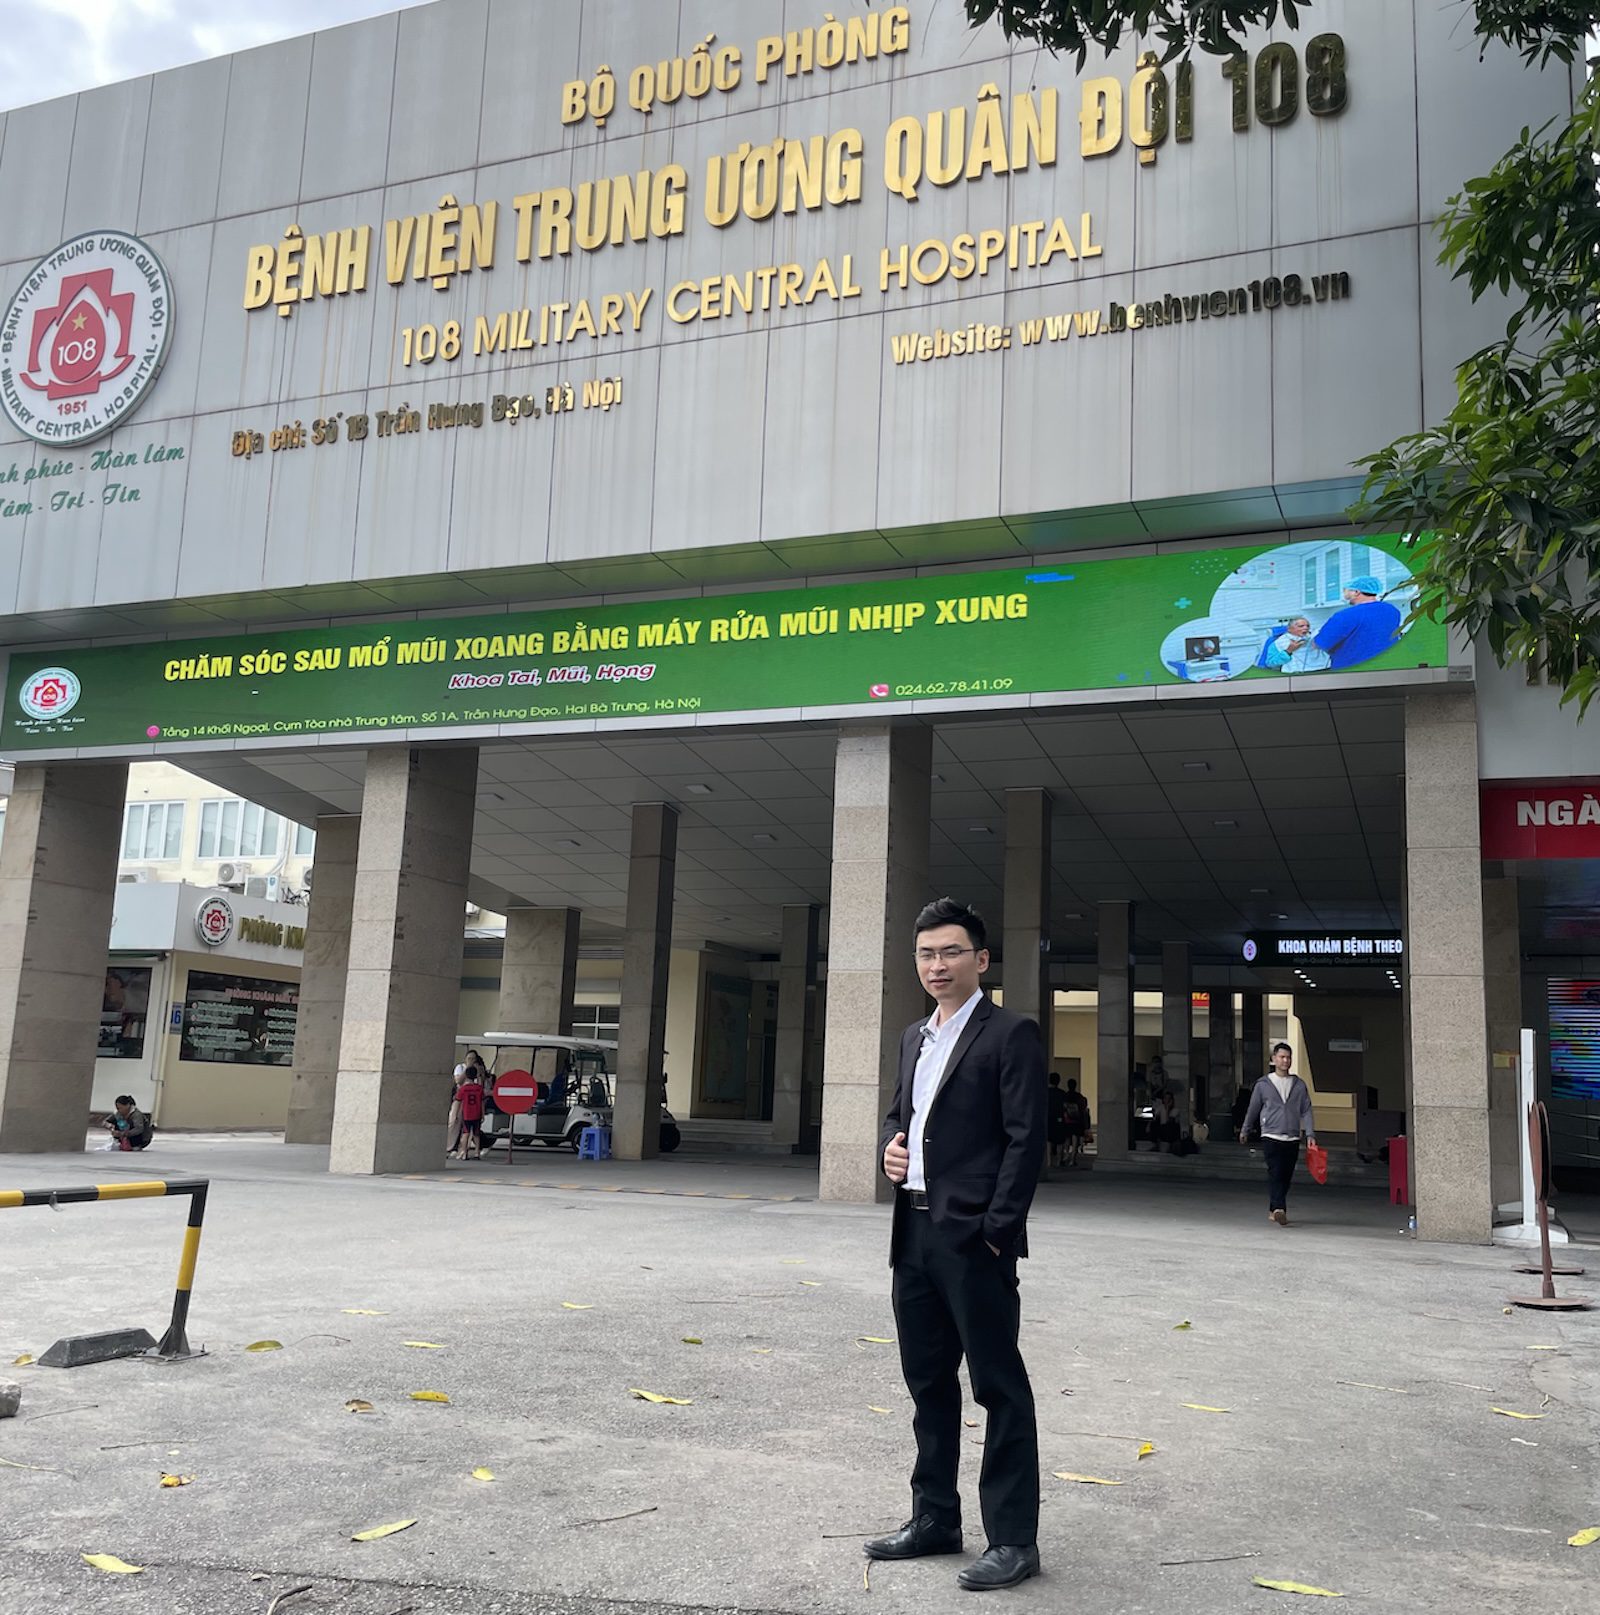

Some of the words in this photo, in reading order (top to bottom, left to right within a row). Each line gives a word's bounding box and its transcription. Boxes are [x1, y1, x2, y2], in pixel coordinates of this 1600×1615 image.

[561, 64, 616, 127] BỘ
[629, 32, 742, 114] QUỐC
[756, 6, 910, 83] PHÒNG
[243, 223, 372, 318] BỆNH
[386, 193, 499, 290] VIỆN
[513, 164, 688, 263] TRUNG
[704, 127, 864, 229] ƯƠNG
[884, 82, 1057, 201] QUÂN
[1079, 50, 1193, 166] ĐỘI
[1222, 33, 1348, 132] 108
[3, 306, 23, 353] BỆNH
[18, 268, 49, 303] VIỆN
[48, 239, 95, 271] TRUNG
[100, 237, 137, 260] ƯƠNG
[135, 254, 161, 293] QUÂN
[149, 296, 166, 328] ĐỘI
[402, 319, 461, 366] 108
[474, 287, 653, 355] MILITARY
[666, 253, 861, 324] CENTRAL
[880, 212, 1103, 292] HOSPITAL
[891, 322, 1011, 365] Website:
[1019, 270, 1351, 346] www.benhvien108.vn
[58, 337, 97, 366] 108
[1, 368, 34, 425] MILITARY
[36, 415, 102, 438] CENTRAL
[104, 343, 159, 419] HOSPITAL
[56, 399, 88, 416] 1951
[232, 429, 264, 459] Địa
[311, 411, 344, 446] Số
[346, 414, 368, 441] 1B
[375, 402, 420, 437] Trần
[428, 401, 484, 430] Hưng
[492, 394, 541, 425] Đạo,
[546, 382, 575, 414] Hà
[583, 376, 623, 412] Nội
[144, 443, 185, 464] lâm
[0, 498, 33, 518] âm
[164, 653, 233, 682] CHĂM
[238, 650, 287, 676] SÓC
[294, 648, 341, 672] SAU
[348, 635, 393, 667] MỔ
[396, 636, 446, 666] MŨI
[454, 633, 544, 662] XOANG
[552, 622, 629, 654] BẰNG
[637, 620, 702, 649] MÁY
[709, 609, 769, 643] RỬA
[779, 606, 839, 638] MŨI
[848, 602, 926, 634] NHỊP
[935, 593, 1028, 625] XUNG
[449, 672, 502, 690] Khoa
[509, 669, 542, 687] Tai,
[548, 665, 591, 684] Mũi,
[596, 662, 656, 684] Họng
[895, 678, 1013, 696] 024.62.78.41.09
[193, 726, 205, 736] 14
[328, 716, 352, 727] nhà
[355, 715, 388, 728] Trung
[565, 704, 588, 715] Hai
[590, 702, 608, 713] Bà
[655, 698, 674, 709] Hà
[677, 697, 701, 709] Nội
[1517, 793, 1600, 827] NGÀ
[1278, 939, 1307, 953] KHOA
[1309, 936, 1341, 953] KHÁM
[1343, 936, 1373, 956] BỆNH
[1374, 939, 1403, 953] THEO
